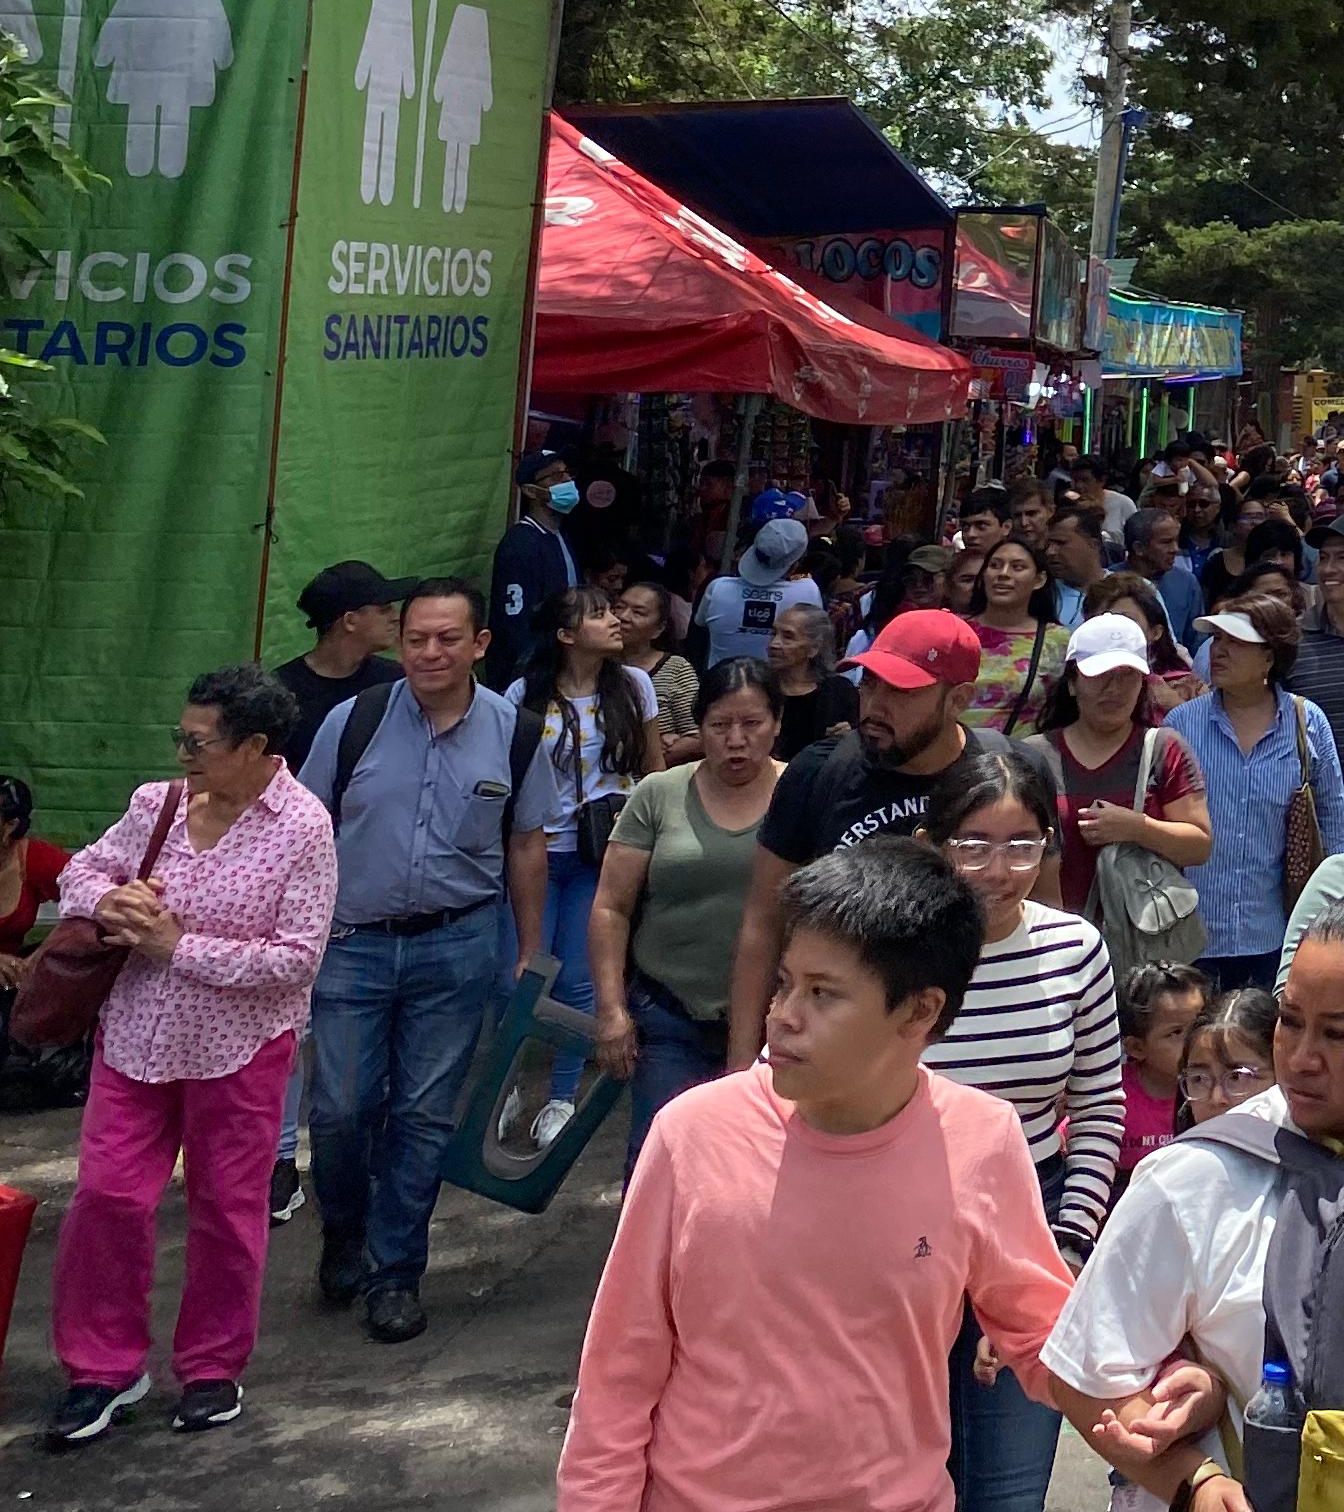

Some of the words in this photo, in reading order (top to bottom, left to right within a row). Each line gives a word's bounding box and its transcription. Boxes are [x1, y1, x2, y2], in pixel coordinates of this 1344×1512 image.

[327, 240, 493, 297] SERVICIOS
[323, 314, 491, 361] SANITARIOS
[971, 350, 1029, 369] Churros
[505, 583, 524, 616] 3
[742, 588, 783, 602] sears
